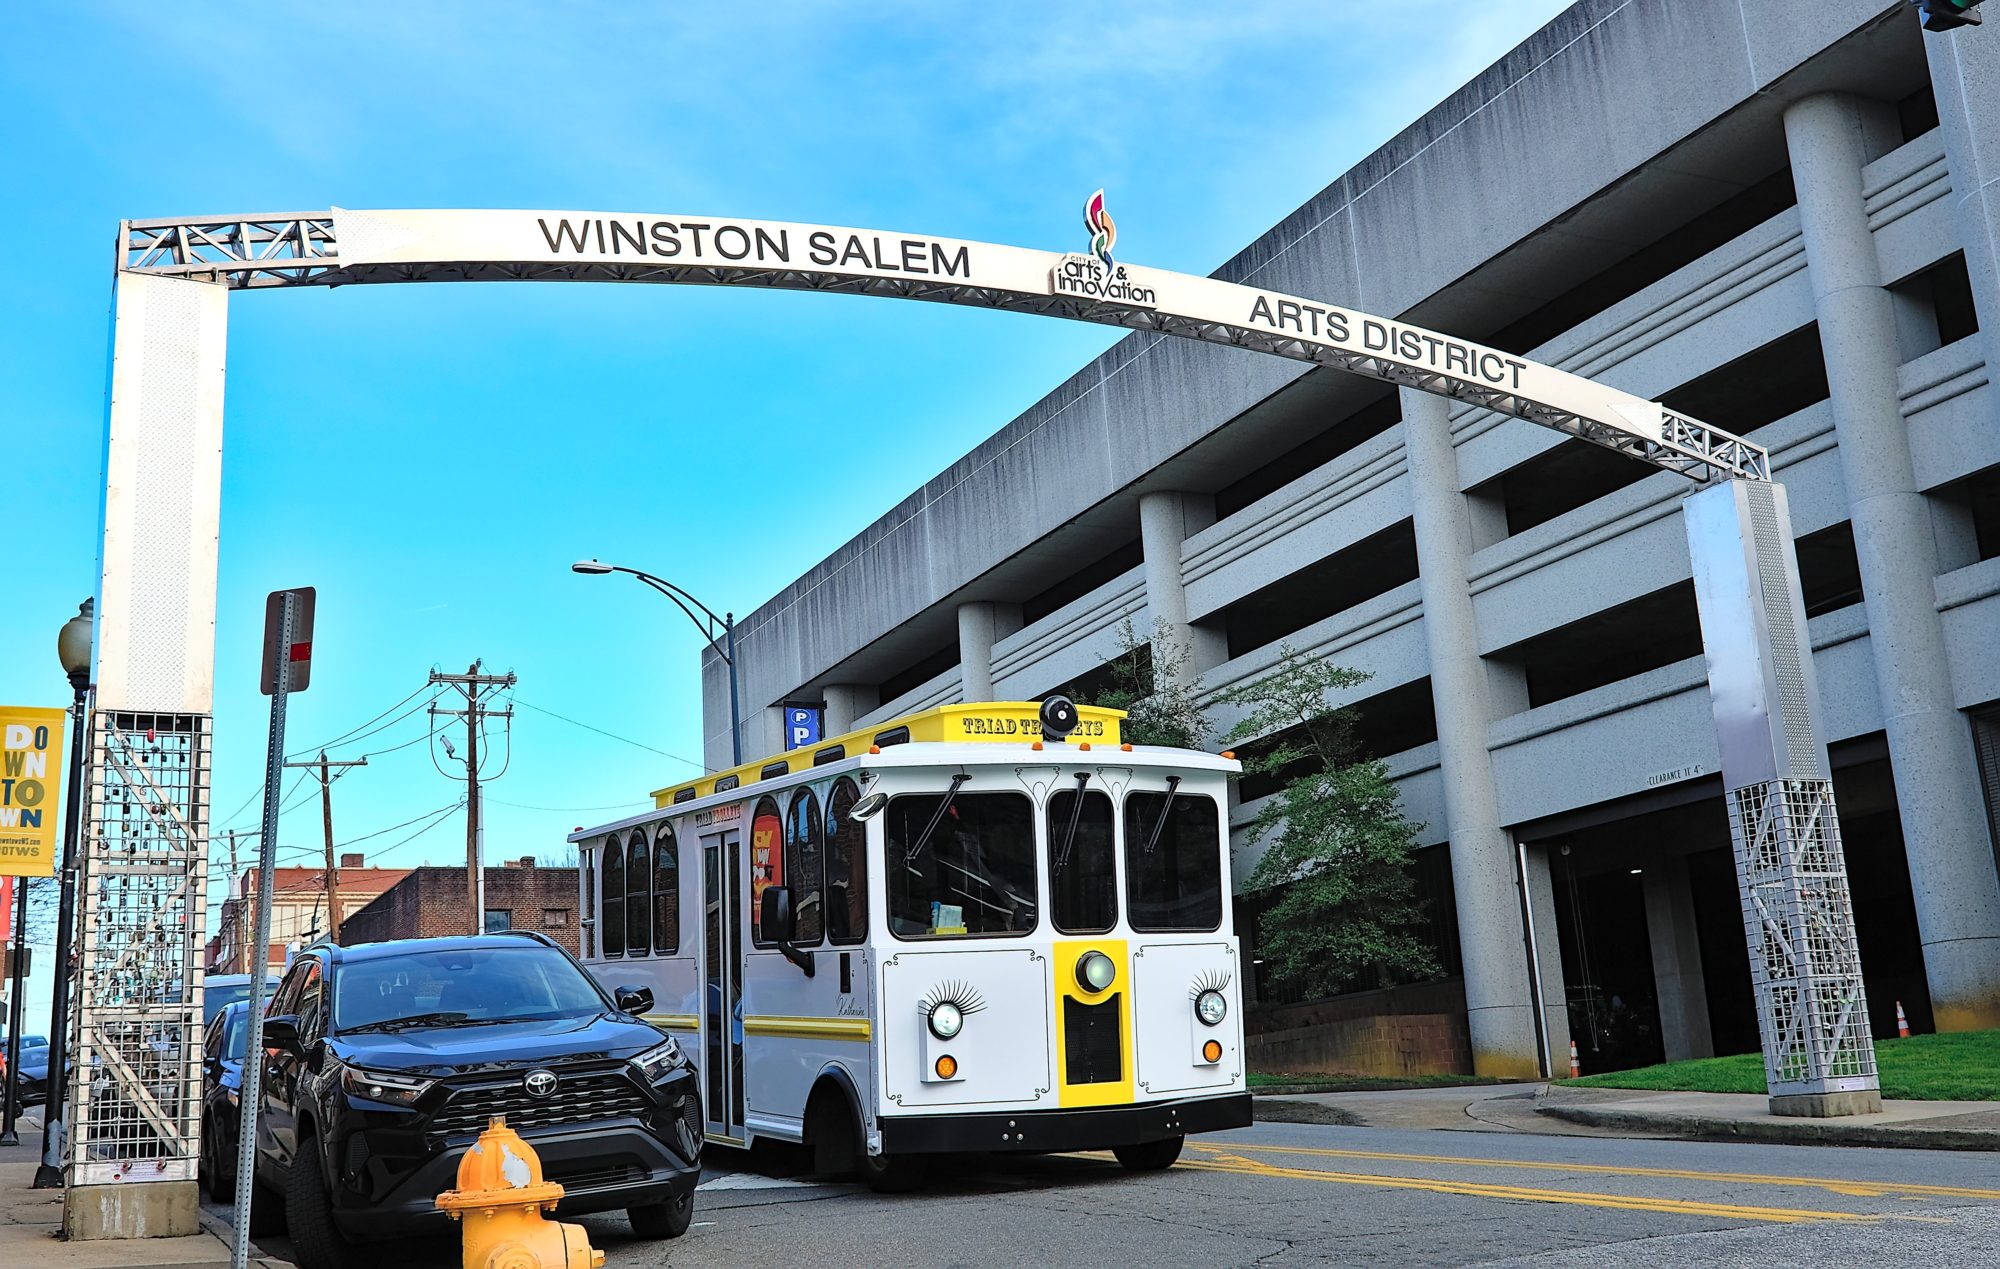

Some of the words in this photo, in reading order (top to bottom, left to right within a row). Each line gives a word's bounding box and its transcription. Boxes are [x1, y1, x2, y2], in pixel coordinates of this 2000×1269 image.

[538, 218, 790, 263] WINSTON
[808, 231, 970, 278] SALEM
[1065, 260, 1102, 282] arts
[1116, 266, 1127, 280] &
[1249, 295, 1350, 342] ARTS
[1363, 319, 1527, 389] DISTRICT
[795, 712, 807, 722] P
[963, 717, 1017, 735] TRIAD
[1020, 719, 1104, 736] TREYS
[5, 724, 49, 750] DO
[794, 727, 810, 748] P
[4, 751, 46, 778] WN
[2, 778, 45, 808] TO
[0, 808, 42, 827] WN
